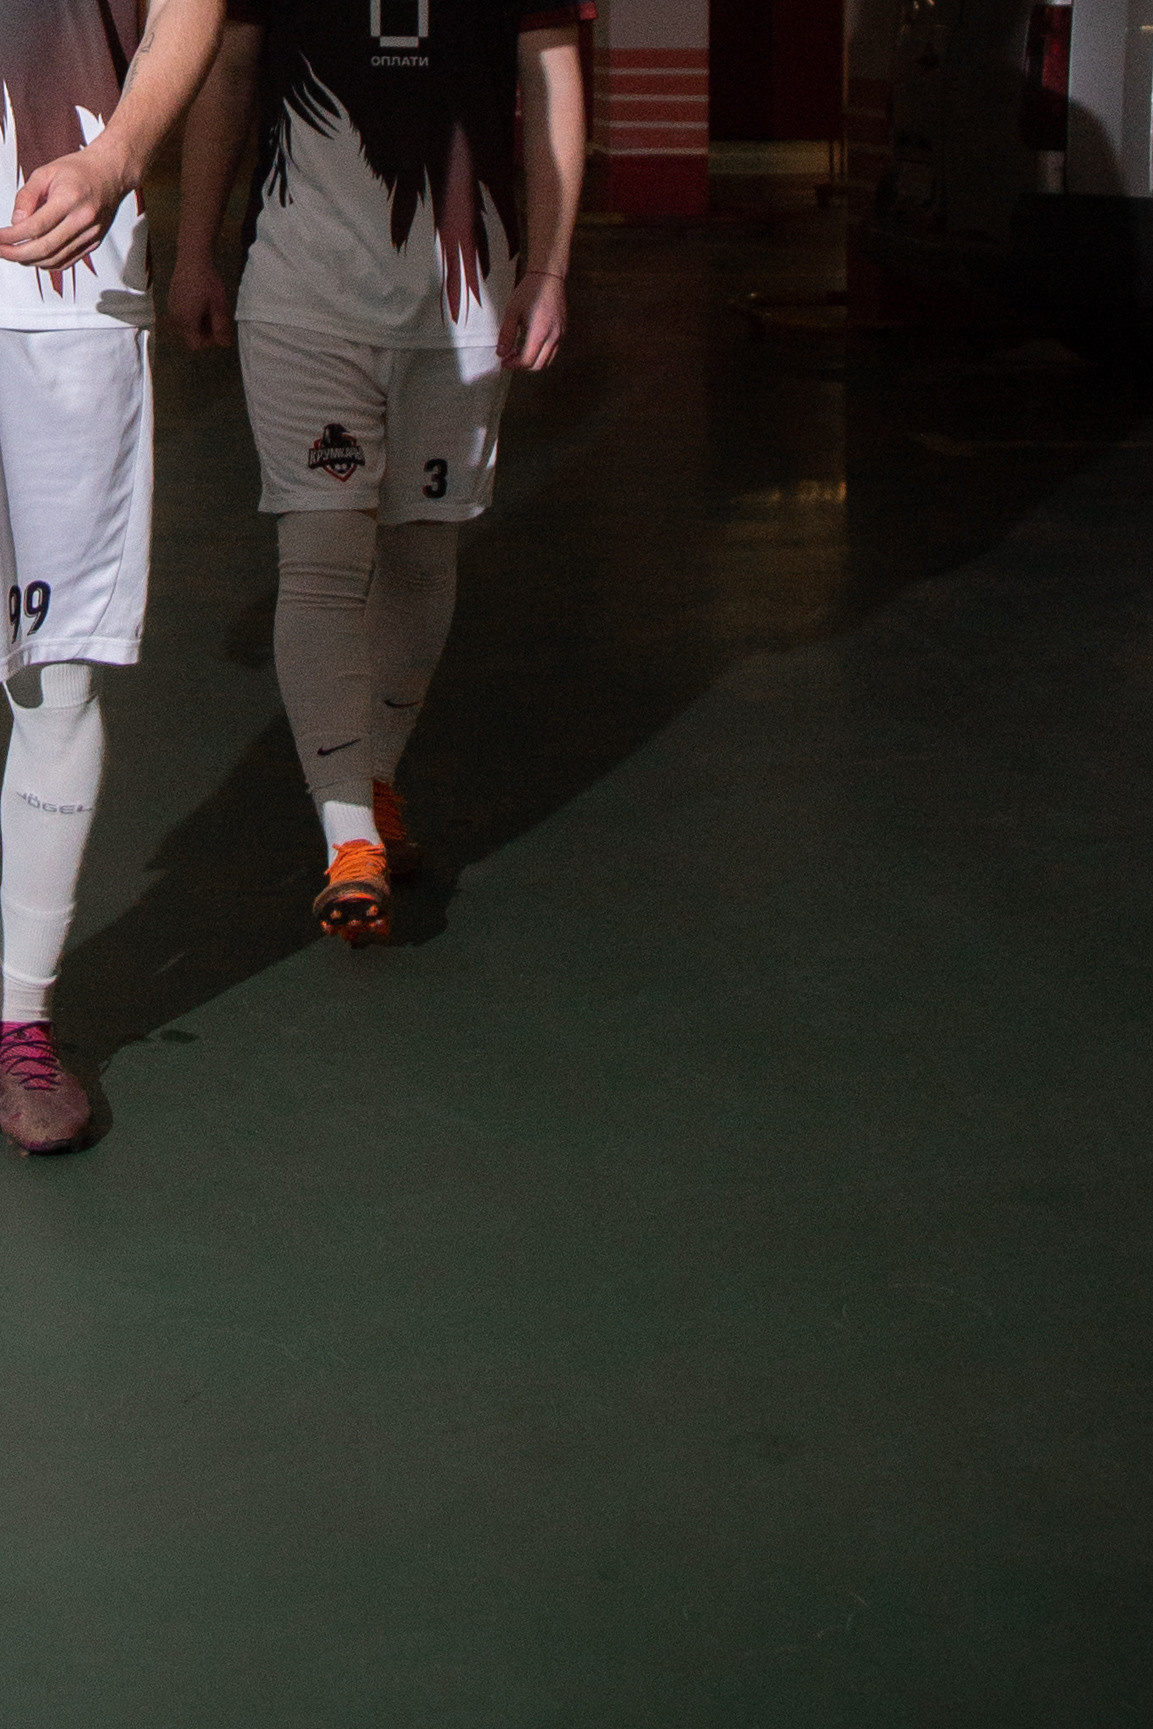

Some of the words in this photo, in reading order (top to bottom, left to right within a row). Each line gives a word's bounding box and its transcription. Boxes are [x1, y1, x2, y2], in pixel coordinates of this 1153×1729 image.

[370, 55, 429, 67] ОПЛАТИ
[422, 458, 448, 499] 3
[8, 579, 52, 644] 99
